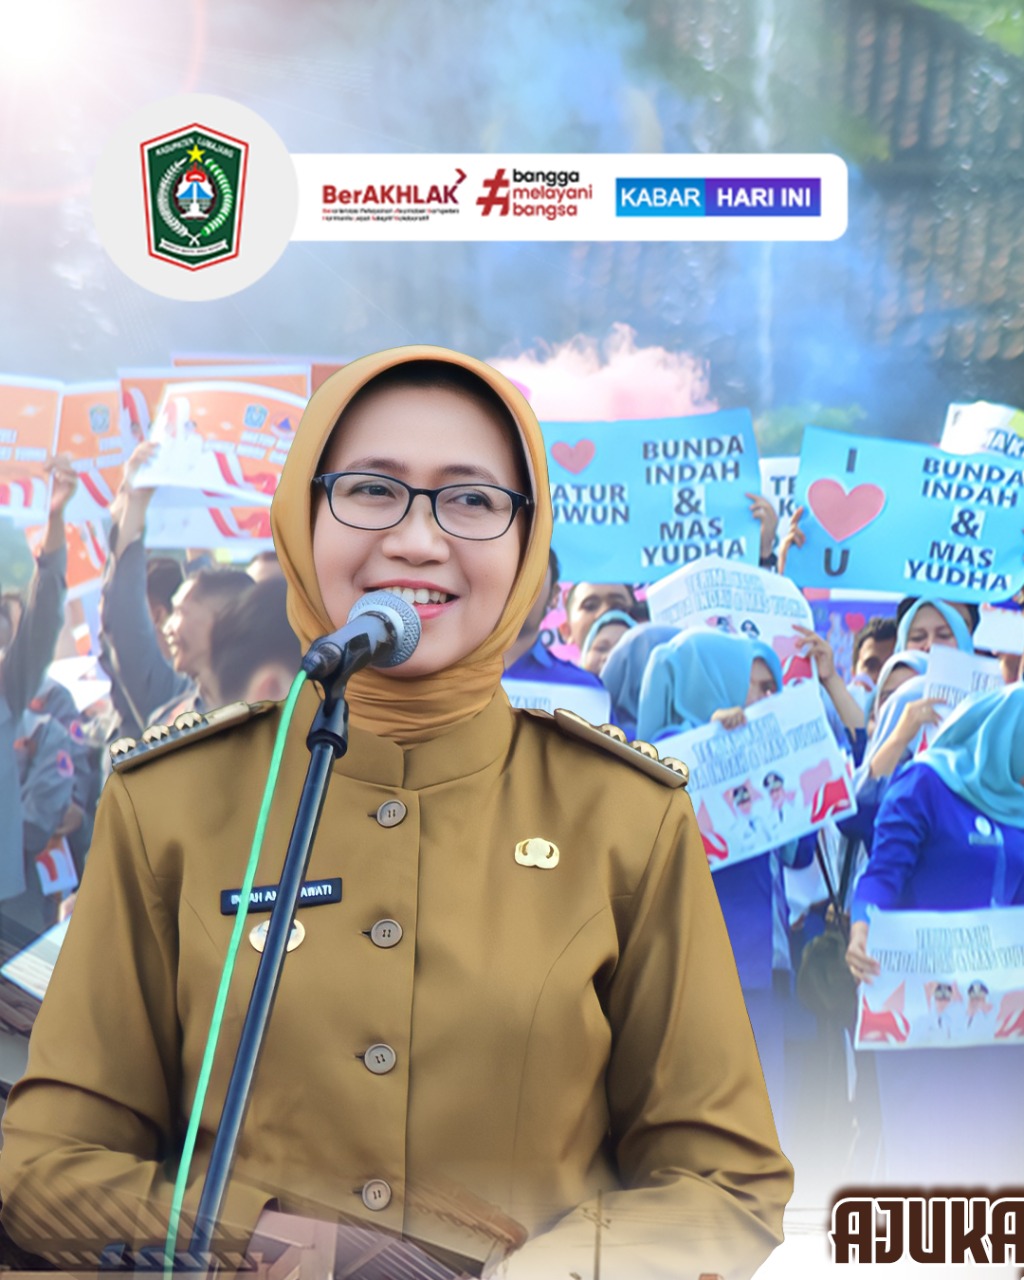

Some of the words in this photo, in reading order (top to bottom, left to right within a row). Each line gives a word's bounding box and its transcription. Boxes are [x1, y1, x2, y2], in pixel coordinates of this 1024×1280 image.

[642, 435, 744, 461] BUNDA
[846, 448, 858, 473] I
[645, 460, 740, 486] INDAH
[551, 484, 626, 503] ATUR
[674, 486, 703, 517] &
[921, 479, 1019, 508] INDAH
[659, 517, 723, 542] MAS
[951, 509, 980, 538] &
[642, 538, 745, 566] YUDHA
[824, 548, 849, 577] U
[929, 541, 994, 568] MAS
[907, 560, 1009, 591] YUDHA
